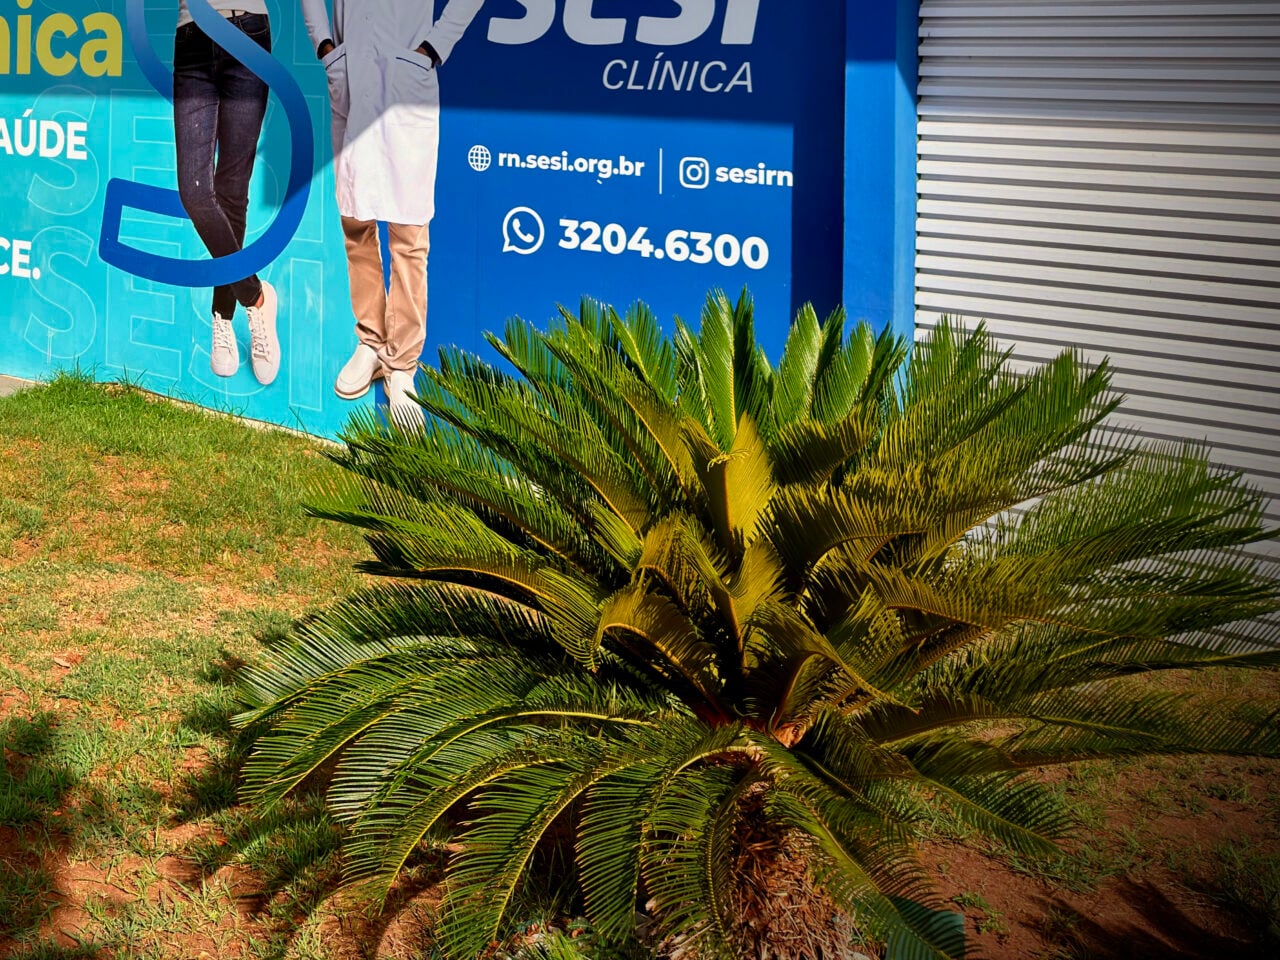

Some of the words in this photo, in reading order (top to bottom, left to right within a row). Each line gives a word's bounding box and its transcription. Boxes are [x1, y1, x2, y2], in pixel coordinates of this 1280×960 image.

[602, 52, 754, 93] CLÍNICA
[498, 150, 645, 180] rn.sesi.org.br
[716, 162, 794, 187] sesirn
[558, 218, 769, 270] 3204.6300
